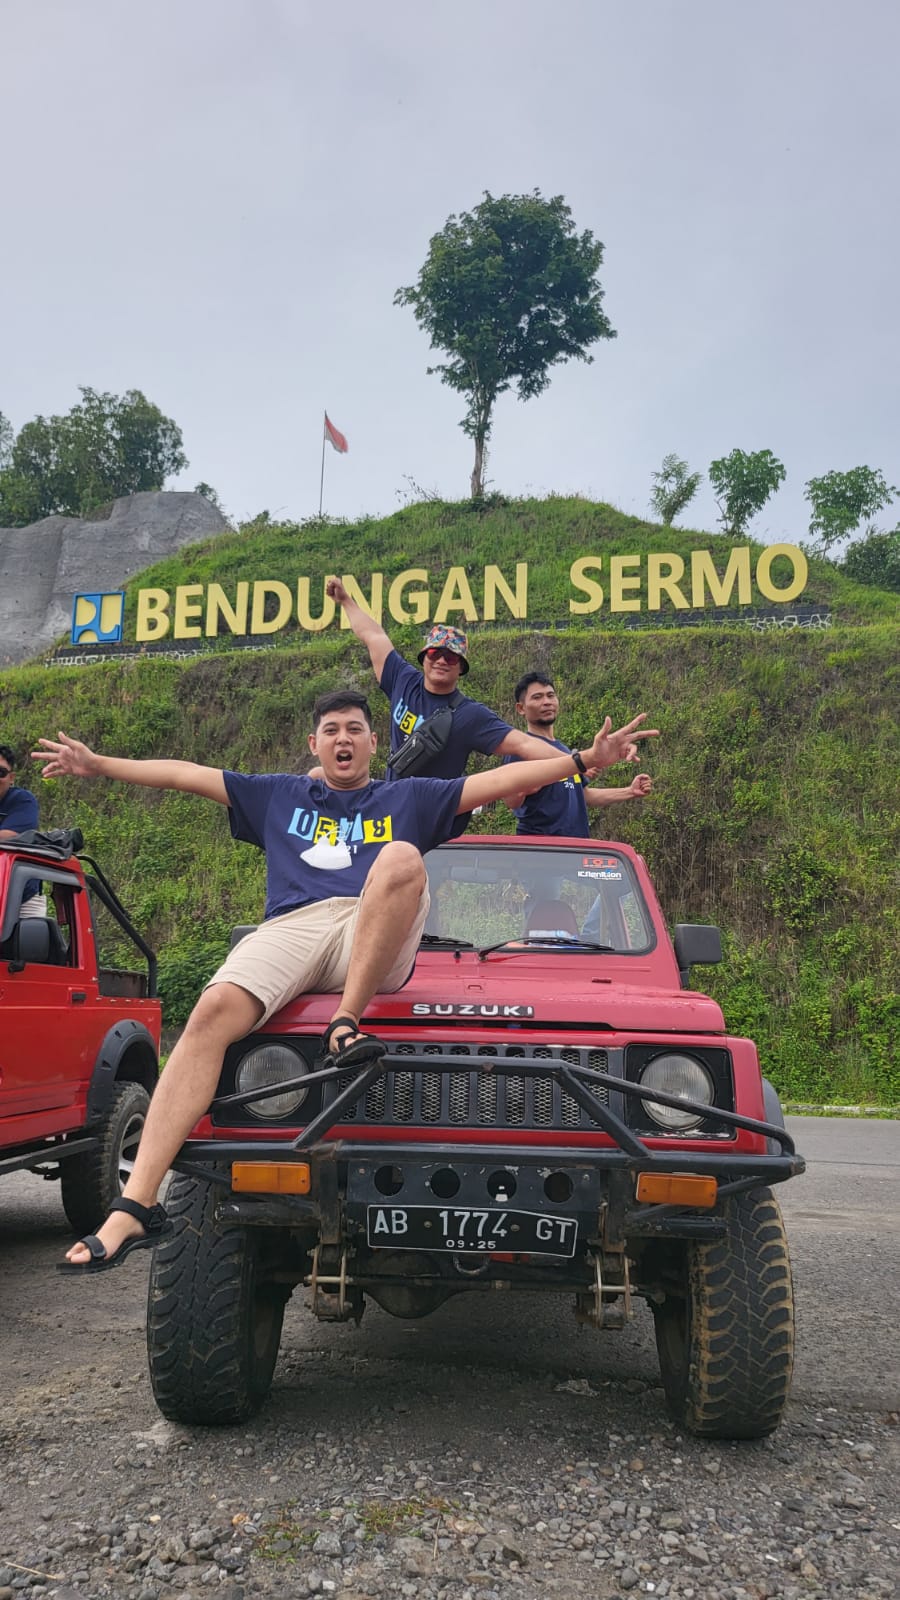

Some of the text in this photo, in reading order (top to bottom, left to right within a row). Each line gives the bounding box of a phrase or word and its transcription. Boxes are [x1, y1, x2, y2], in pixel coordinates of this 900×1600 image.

[135, 542, 809, 642] BENDUNGAN SERMO
[412, 1003, 533, 1016] SUZUKI
[374, 1210, 573, 1243] AB 1774 GT
